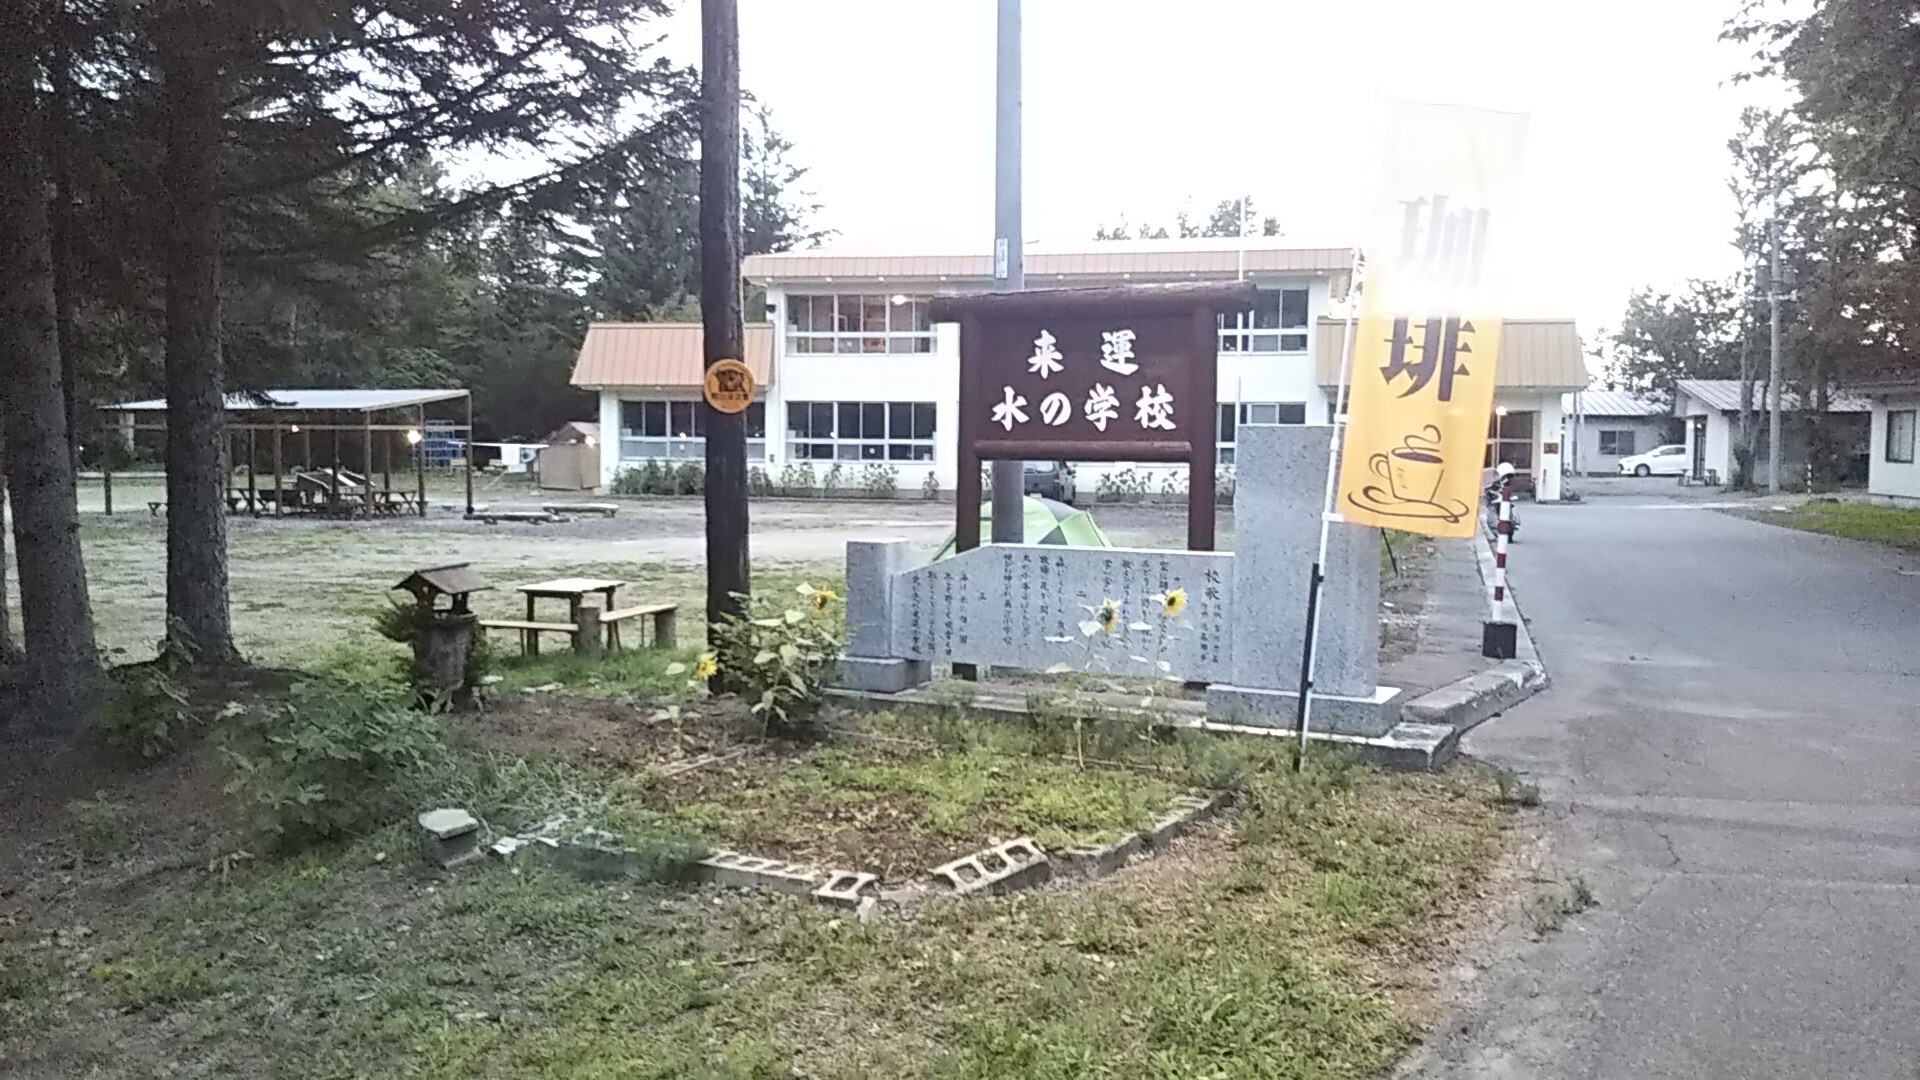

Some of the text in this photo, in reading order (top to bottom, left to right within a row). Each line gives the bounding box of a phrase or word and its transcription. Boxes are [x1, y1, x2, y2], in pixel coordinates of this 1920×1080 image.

[1379, 194, 1491, 402] 珈琲
[1027, 329, 1140, 379] 来運
[991, 382, 1177, 431] 水の学校
